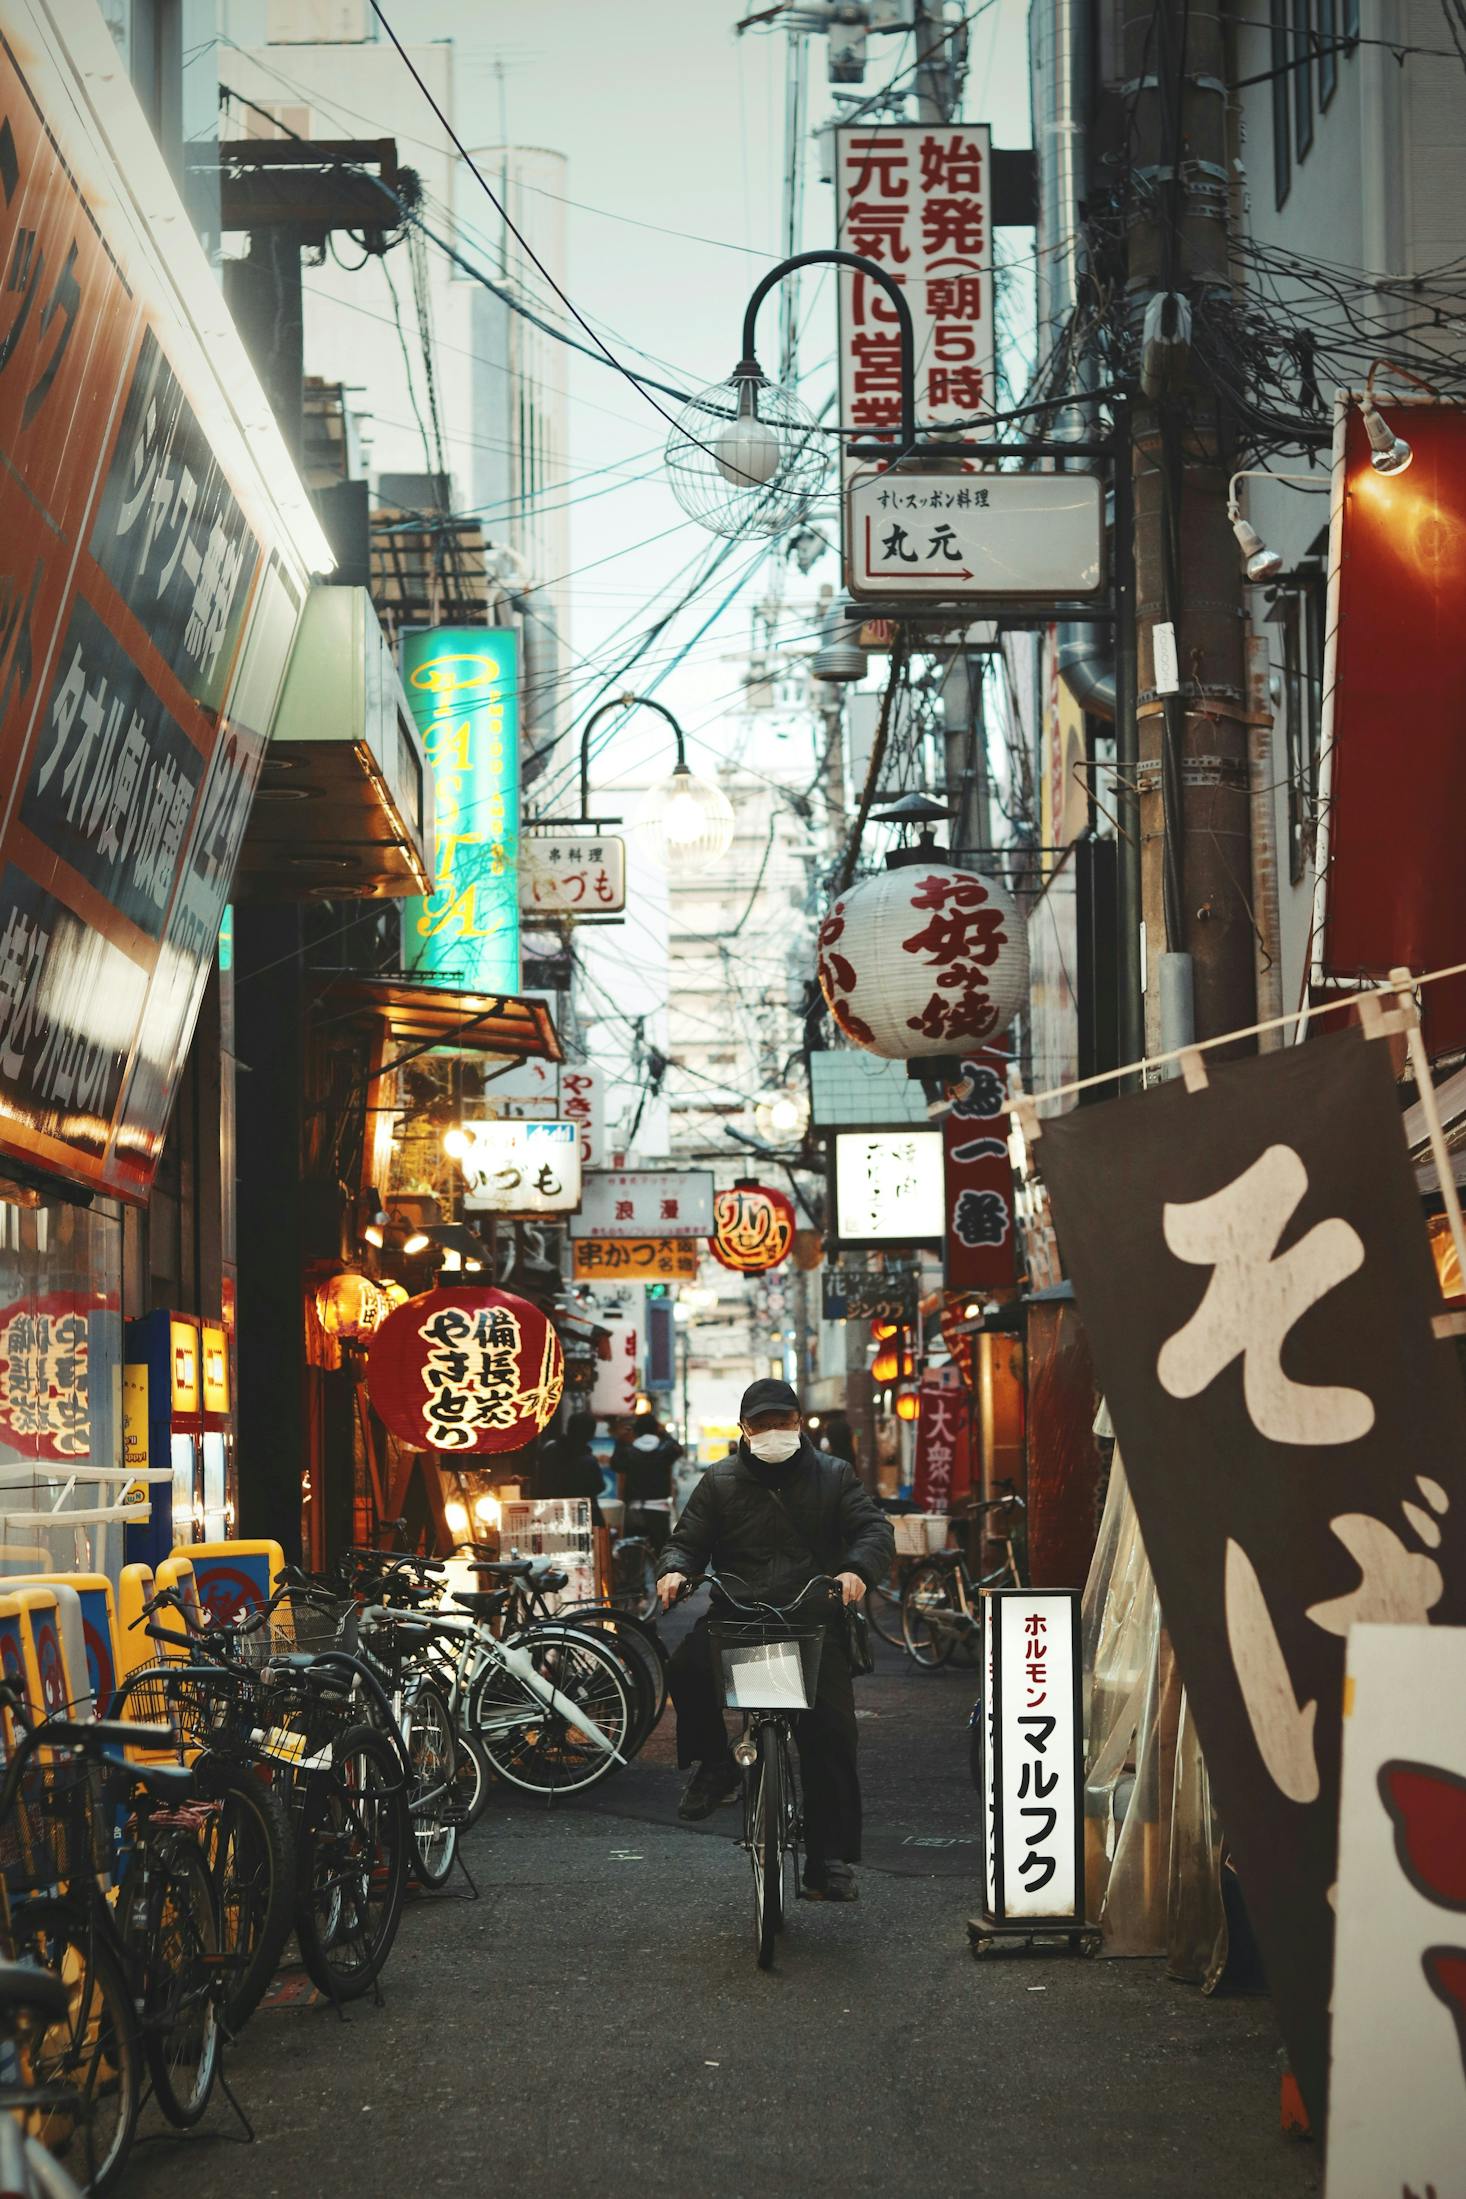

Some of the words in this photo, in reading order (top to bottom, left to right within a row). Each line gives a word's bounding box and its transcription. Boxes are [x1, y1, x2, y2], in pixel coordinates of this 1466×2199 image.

[846, 138, 911, 472] 元気に営業
[116, 397, 244, 684] シャワー無料
[881, 523, 963, 562] 丸元
[37, 642, 195, 909] タオル使い放題
[532, 869, 615, 902] いづも
[548, 848, 605, 863] 串料理
[902, 874, 1008, 1040] お好み焼
[578, 1242, 656, 1268] 串かつ
[420, 1311, 476, 1447] やきとり
[471, 1309, 523, 1427] 備長炭
[1157, 1144, 1449, 1804] そば
[1024, 1614, 1047, 1708] ホルモン
[1017, 1716, 1059, 1893] マルフク
